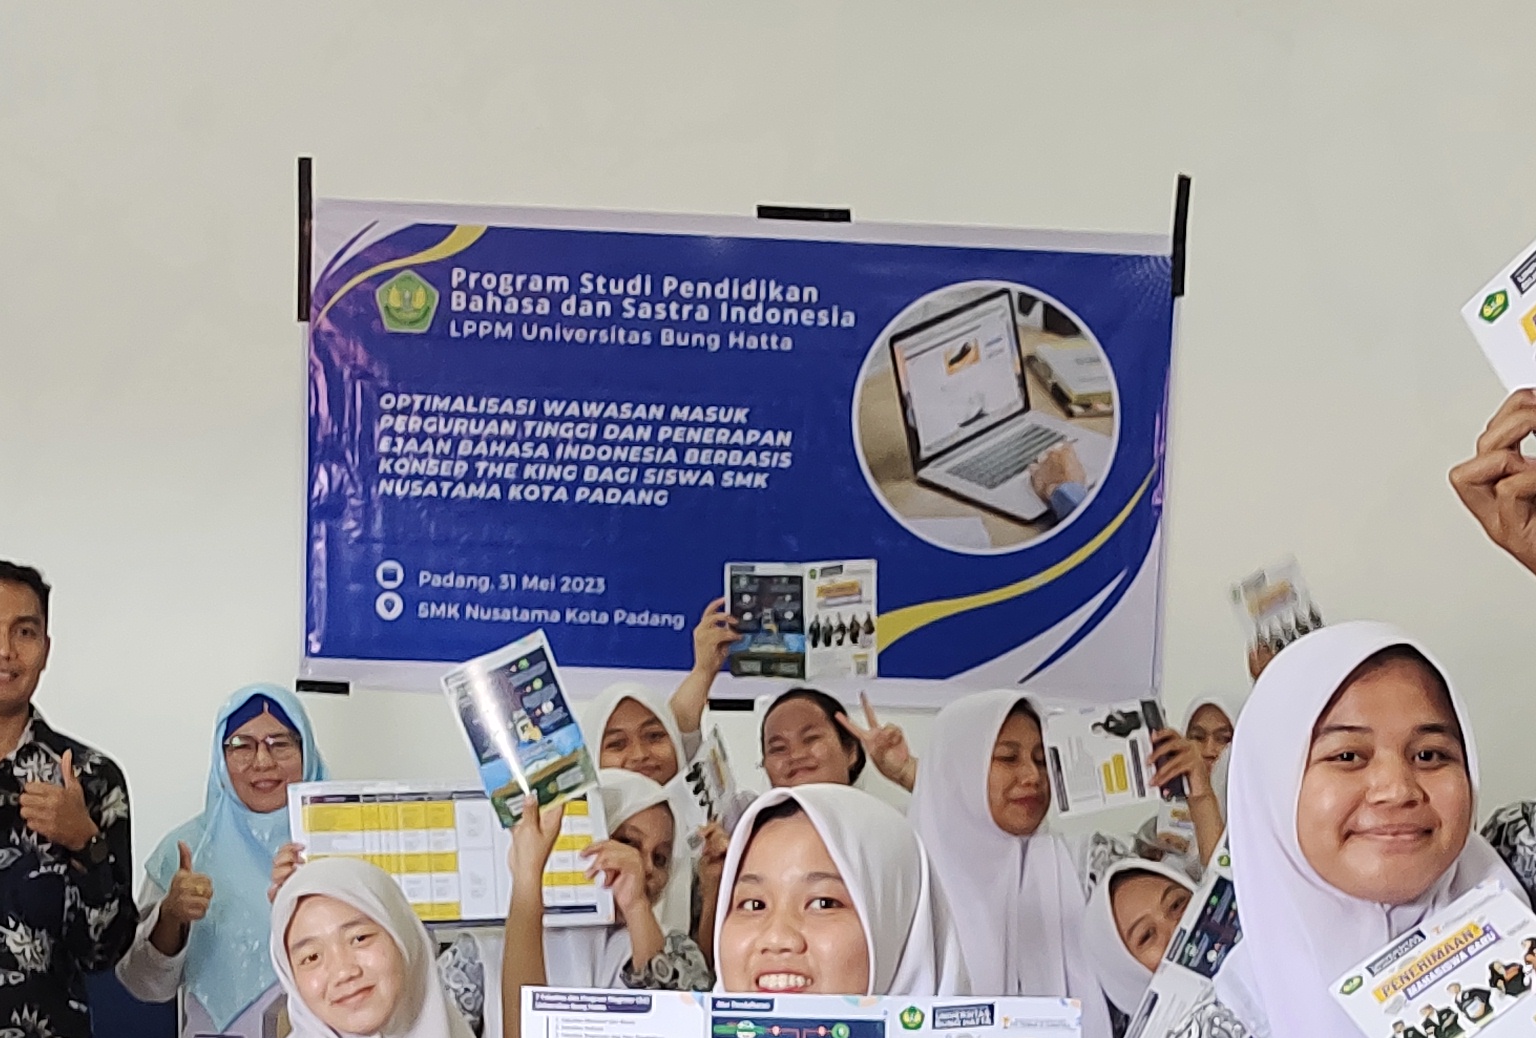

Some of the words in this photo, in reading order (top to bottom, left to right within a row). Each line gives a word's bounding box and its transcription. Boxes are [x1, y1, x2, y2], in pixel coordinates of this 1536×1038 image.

[451, 267, 569, 295] Program
[579, 272, 652, 296] Studi
[663, 276, 818, 303] Pendidikan
[450, 293, 550, 315] Bahasa
[561, 297, 612, 319] dan
[622, 299, 710, 321] Sastra
[720, 304, 856, 328] Indonesia
[449, 320, 513, 340] LPPM
[521, 322, 652, 347] Universitas
[660, 328, 721, 353] Bung
[729, 332, 793, 352] Hatta
[379, 393, 536, 416] OPTIMALISASI
[544, 399, 665, 420] WAWASAN
[670, 404, 750, 424] MASUK
[378, 414, 517, 437] PERGURUAN
[523, 420, 597, 440] TINGGI
[602, 425, 651, 442] DAN
[658, 426, 793, 447] PENERAPAN
[378, 436, 451, 456] EJAAN
[458, 440, 549, 460] BAHASA
[556, 443, 677, 464] INDONESIA
[684, 447, 793, 469] BERBASIS
[378, 457, 468, 478] KONSEP
[474, 461, 518, 479] THE
[523, 464, 577, 482] KING
[582, 465, 638, 484] BAGI
[643, 468, 716, 487] SISWA
[721, 471, 770, 489] SMK
[377, 479, 501, 501] NUSATAMA
[508, 484, 569, 502] KOTA
[574, 486, 669, 507] PADANG
[498, 573, 516, 591] 31
[521, 573, 557, 592] Mei
[561, 576, 606, 594] 2023
[417, 602, 460, 620] SMK
[465, 603, 561, 623] Nusatama
[565, 607, 609, 625] Kota
[614, 609, 685, 630] Padang
[1381, 929, 1475, 998] PENERIMAAN
